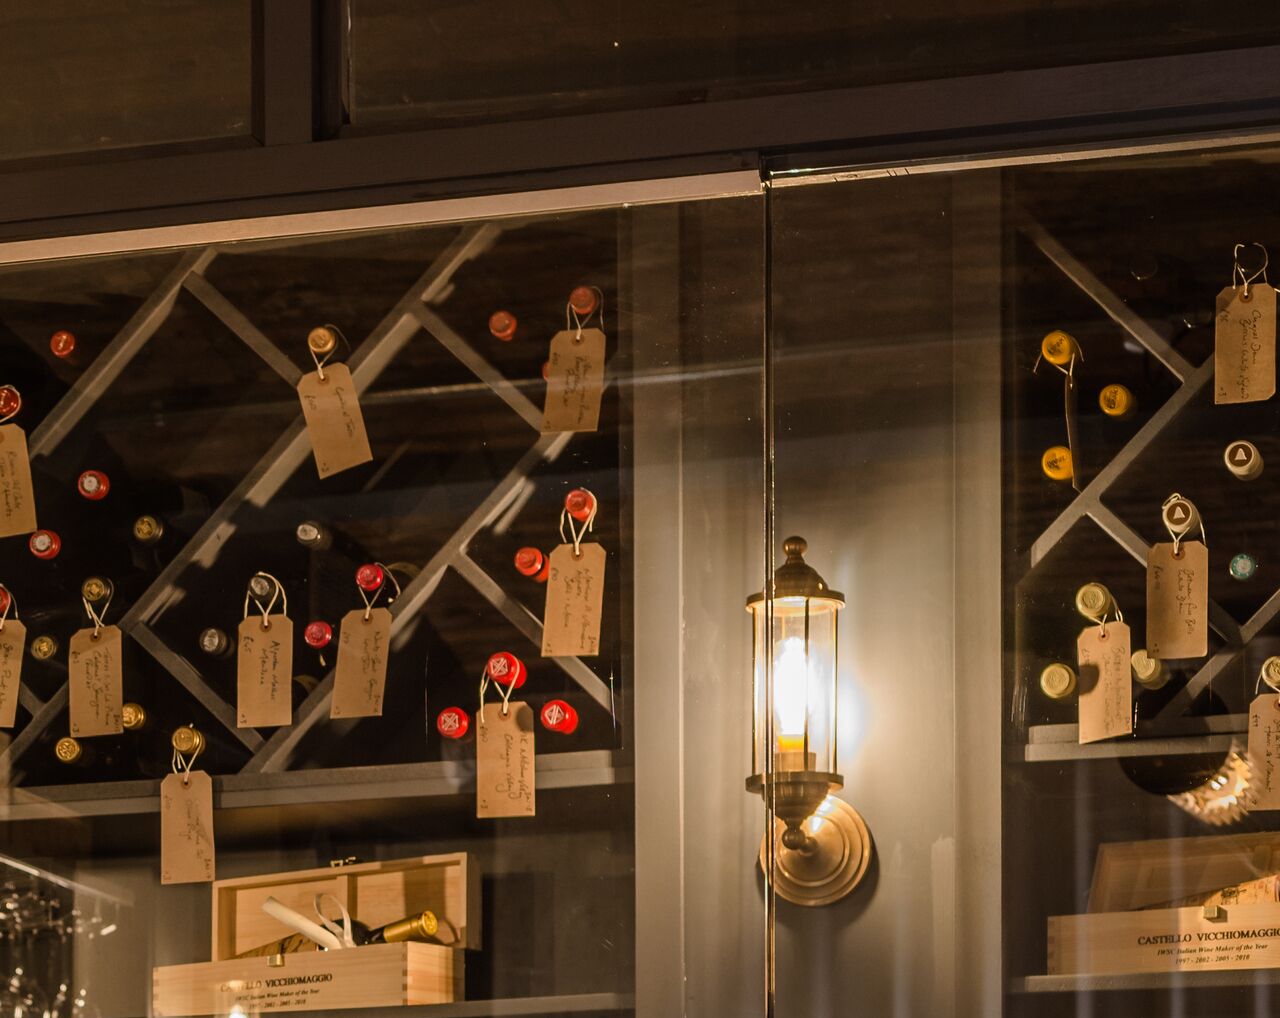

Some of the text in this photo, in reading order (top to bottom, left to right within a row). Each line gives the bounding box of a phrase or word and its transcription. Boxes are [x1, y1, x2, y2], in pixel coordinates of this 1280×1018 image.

[1137, 934, 1192, 945] CASTELLO
[1215, 944, 1235, 952] Maker
[265, 973, 333, 988] VICCHIOMAGGIO
